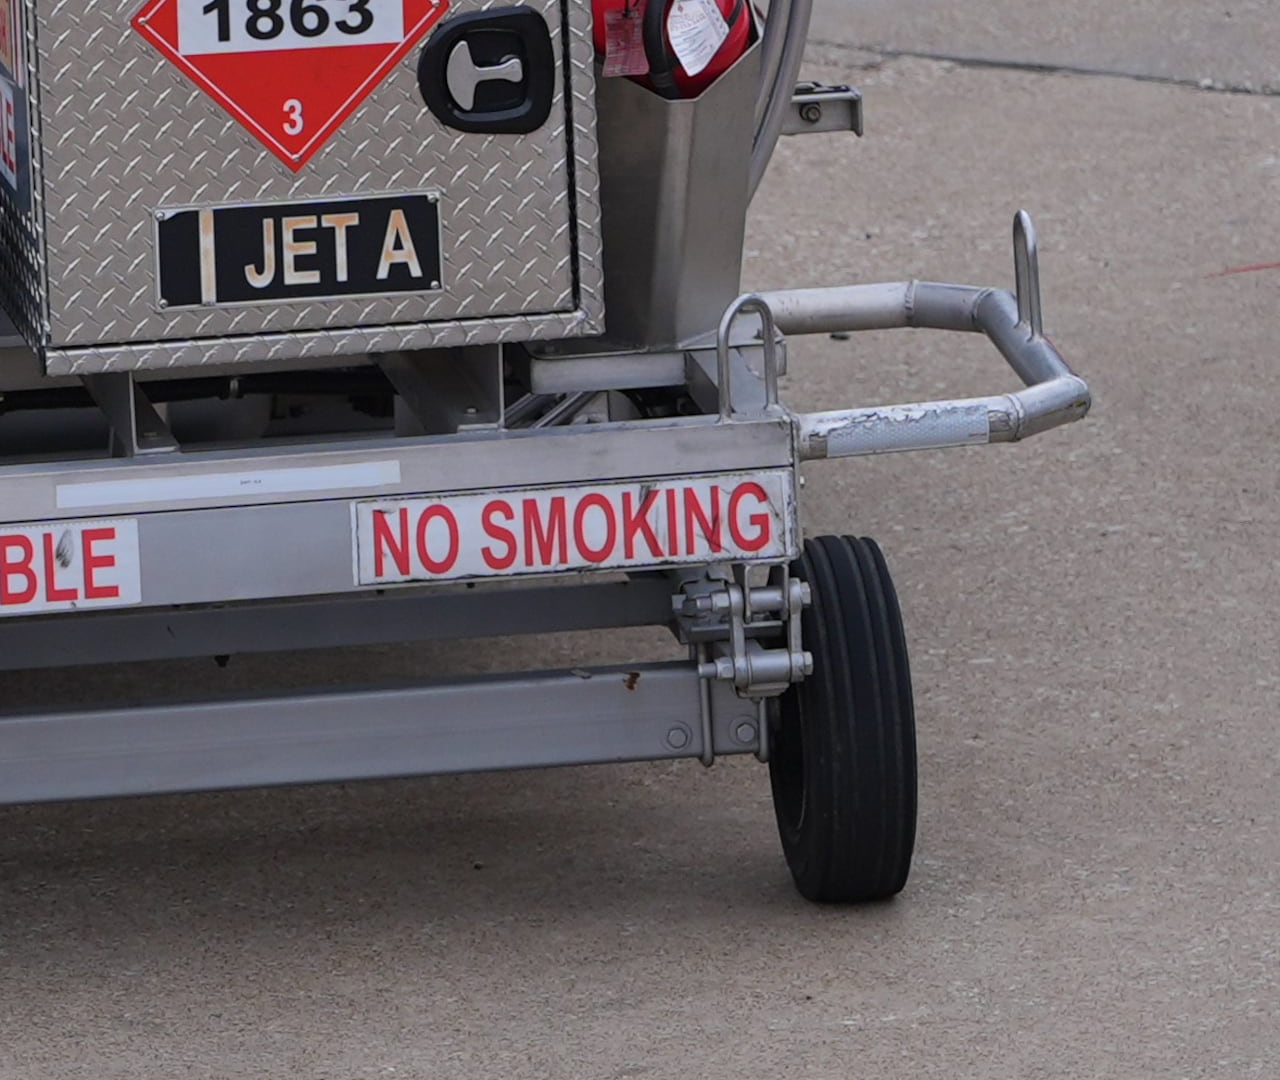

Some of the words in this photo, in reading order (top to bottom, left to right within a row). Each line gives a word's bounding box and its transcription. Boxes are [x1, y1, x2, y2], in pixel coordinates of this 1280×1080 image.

[283, 99, 303, 135] 3
[244, 213, 359, 288] JET
[376, 210, 422, 280] A
[372, 504, 461, 577] NO
[481, 482, 772, 570] SMOKING
